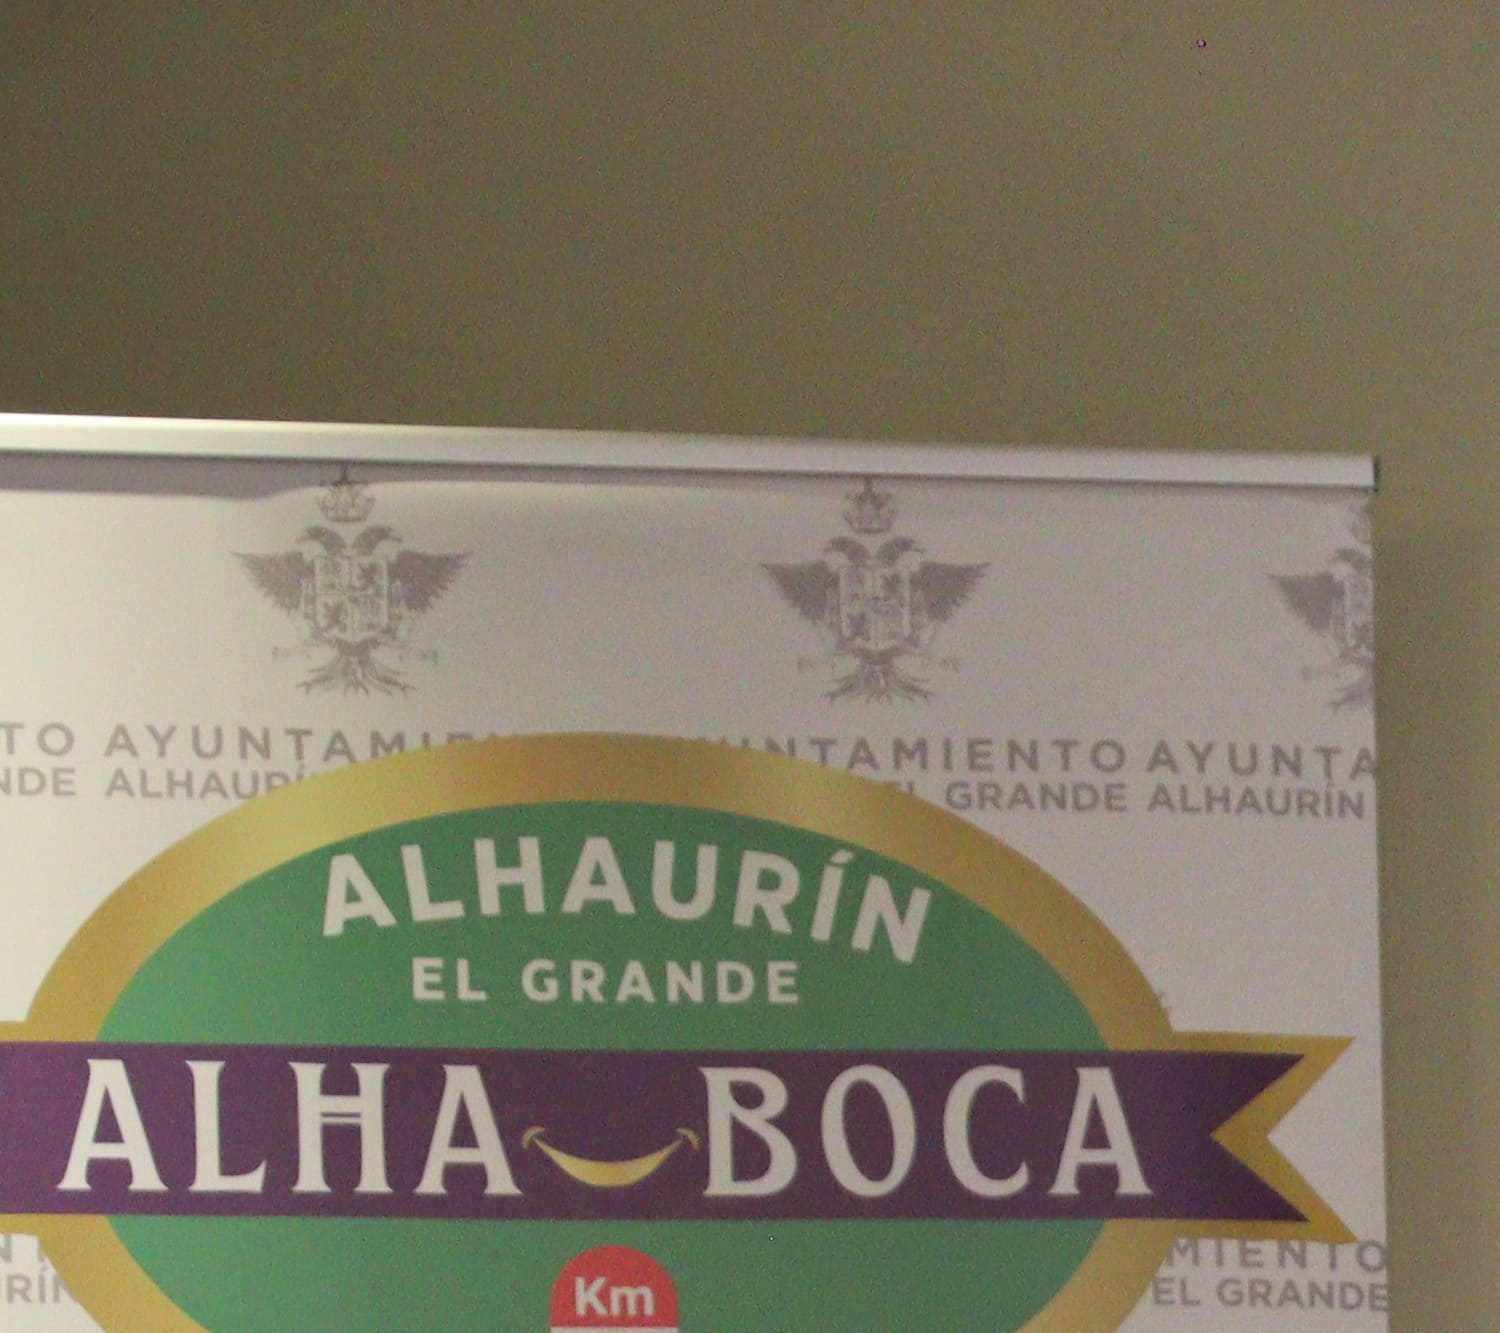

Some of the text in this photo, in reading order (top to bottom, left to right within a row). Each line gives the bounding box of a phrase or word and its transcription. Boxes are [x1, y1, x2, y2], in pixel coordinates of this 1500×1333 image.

[945, 781, 1127, 812] GRANDE
[1147, 781, 1365, 820] ALHAURÍN
[322, 836, 931, 964] ALHAURÍN
[411, 956, 800, 1004] EL GRANDE
[56, 1058, 1154, 1199] ALHA BOCA
[575, 1276, 656, 1317] Km
